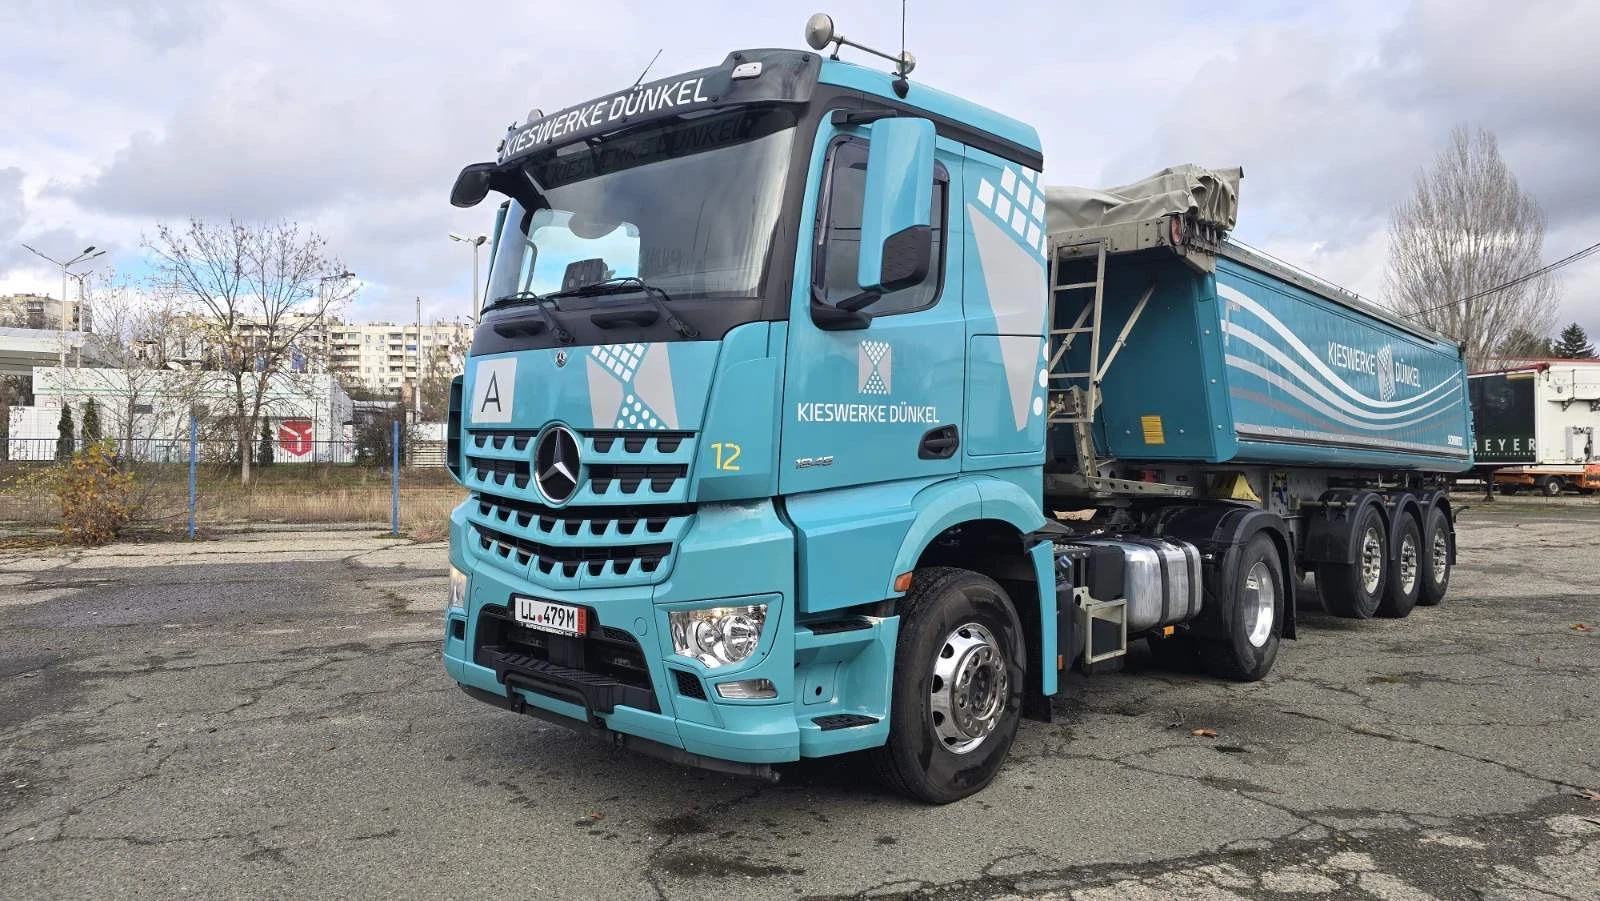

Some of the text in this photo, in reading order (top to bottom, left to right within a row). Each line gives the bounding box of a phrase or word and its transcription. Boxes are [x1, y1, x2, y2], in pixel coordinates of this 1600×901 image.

[503, 77, 708, 159] KIESWERKE DÜNKEL
[1327, 341, 1421, 388] KIESWERKE DÜNKEL
[481, 370, 501, 412] A
[797, 401, 940, 423] KIESWERKE DÜNKEL
[711, 443, 741, 470] 12
[521, 601, 536, 621] LL
[543, 605, 575, 629] 479M
